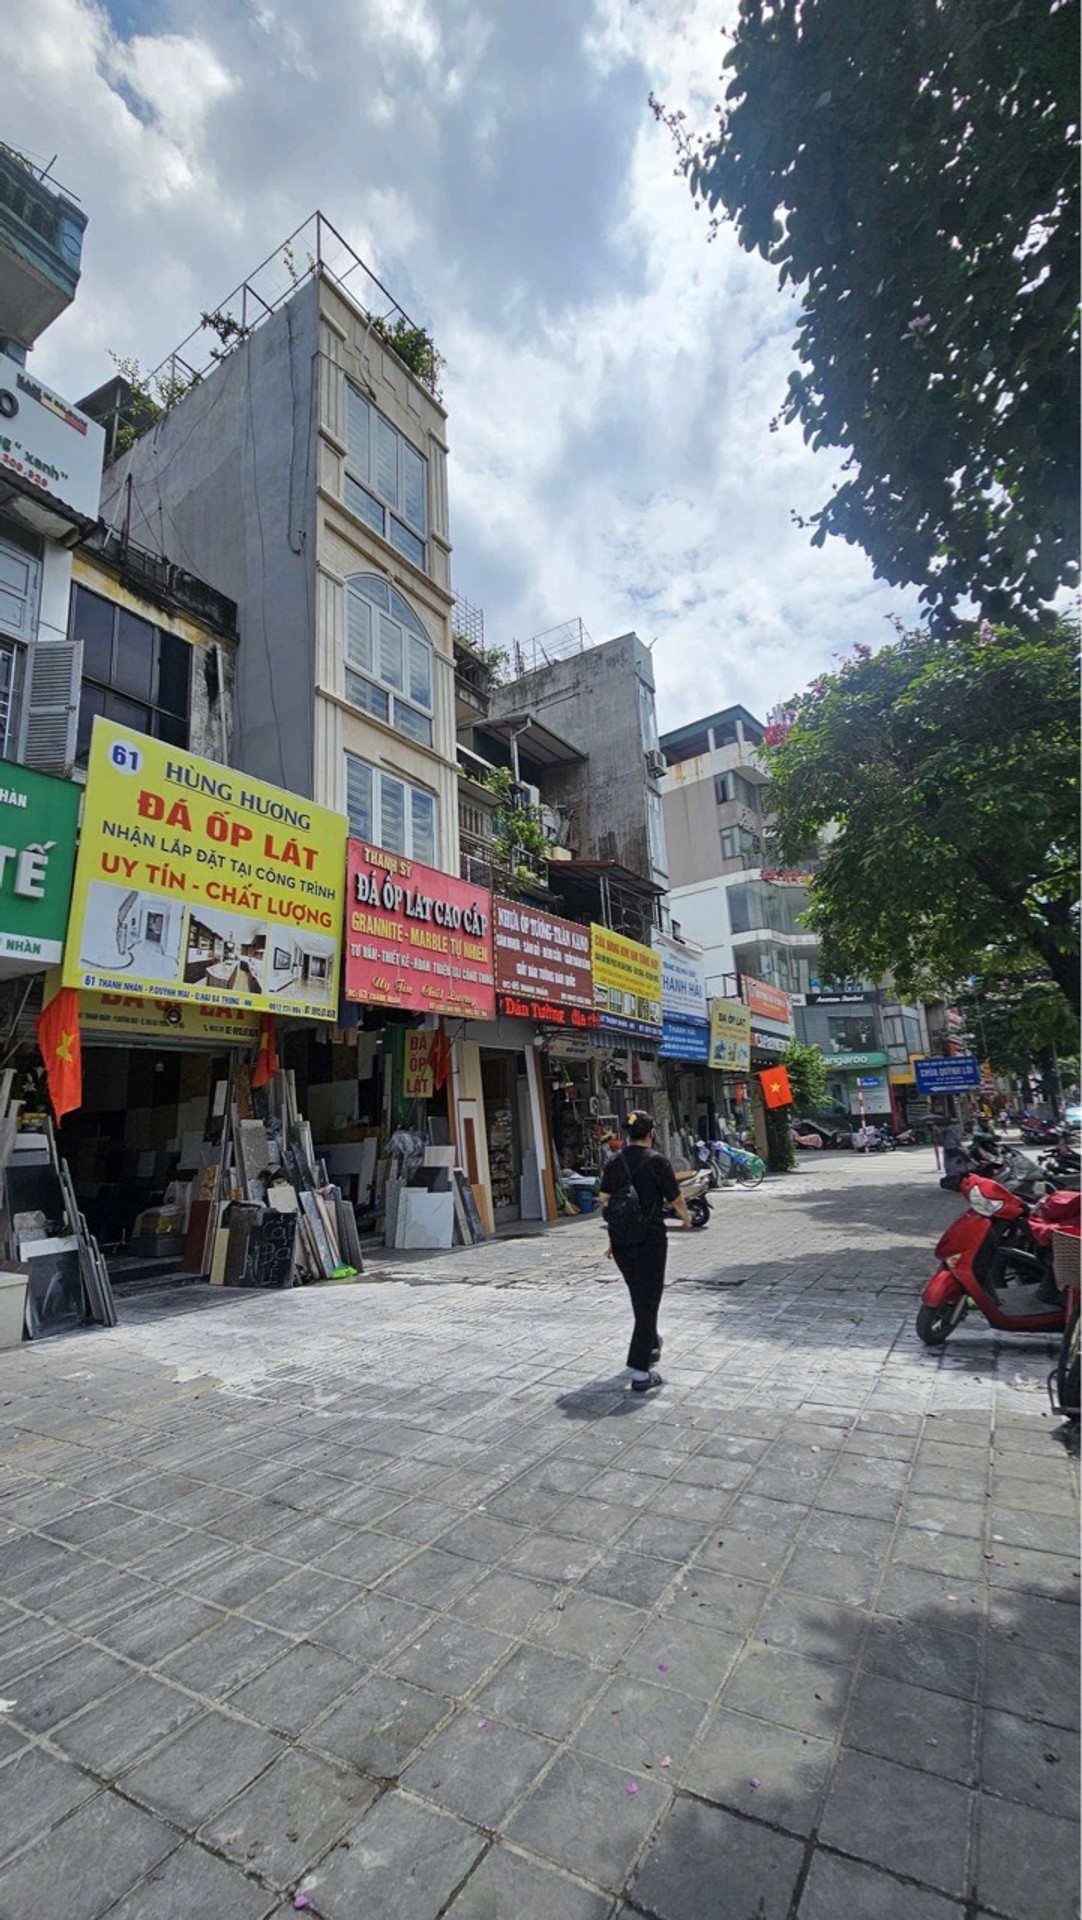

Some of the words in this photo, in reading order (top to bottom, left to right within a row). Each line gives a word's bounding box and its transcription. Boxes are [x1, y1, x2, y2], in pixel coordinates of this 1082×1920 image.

[112, 745, 140, 771] 61
[165, 761, 233, 802] HÙNG
[240, 790, 311, 831] HƯƠNG
[137, 790, 192, 833] ĐÁ
[205, 810, 253, 848] ỐP
[264, 833, 319, 871] LÁT
[102, 820, 155, 848] NHẬN
[161, 833, 192, 858] LẮP
[196, 849, 225, 871] ĐẶT
[230, 858, 252, 878] TẠI
[256, 862, 296, 889] CÔNG
[300, 877, 336, 901] TRÌNH
[100, 852, 139, 879] UY
[145, 861, 187, 891] TÍN
[205, 881, 262, 911] CHẤT
[267, 896, 333, 929] LƯỢNG
[356, 871, 380, 907] ĐÁ
[382, 871, 403, 910] ỐP
[434, 902, 461, 929] CAO
[464, 902, 488, 937] CẤP
[6, 939, 41, 954] NHÀN
[352, 912, 403, 942] GRANNITE
[410, 928, 449, 954] MARBLE
[663, 974, 687, 994] HANH
[410, 1034, 427, 1051] ĐÁ
[409, 1052, 427, 1072] ỐP
[407, 1076, 428, 1094] LÁT
